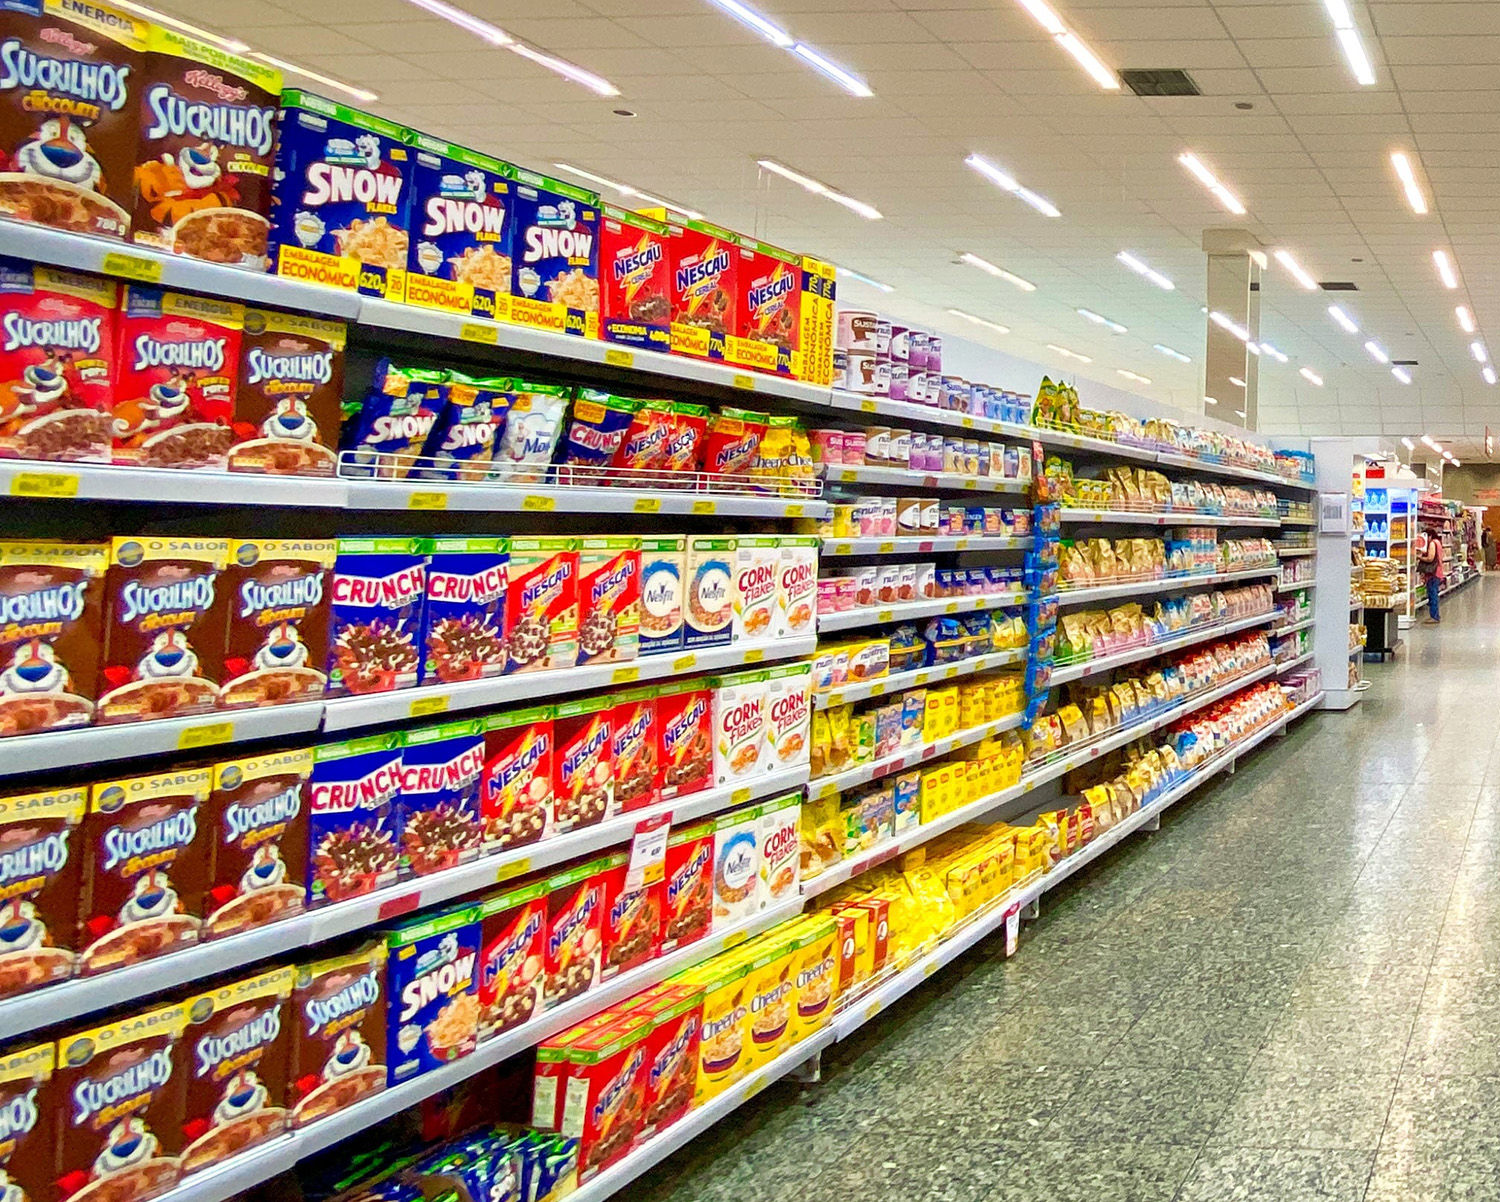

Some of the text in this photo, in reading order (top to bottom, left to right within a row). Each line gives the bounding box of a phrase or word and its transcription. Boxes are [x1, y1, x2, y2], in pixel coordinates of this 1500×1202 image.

[0, 41, 130, 110] SUCRILHOS
[149, 87, 275, 156] SUCRILHOS
[303, 163, 402, 206] SNOW
[425, 197, 506, 236] SNOW
[523, 226, 593, 262] SNOW
[614, 241, 663, 281] NESCAU
[282, 261, 357, 289] ECONÔMICA
[676, 250, 730, 292] NESCAU
[748, 273, 795, 311] NESCAU
[409, 286, 470, 312] ECONÔMICA
[511, 310, 564, 330] ECONÔMICA
[4, 312, 101, 353] SUCRILHOS
[135, 335, 226, 372] SUCRILHOS
[671, 334, 708, 352] CONÔMICA
[249, 350, 333, 384] SUCRILHOS
[169, 541, 229, 552] SABOR
[281, 541, 336, 552] SABOR
[240, 572, 325, 618] SUCRILHOS
[333, 565, 424, 605] CRUNCH
[428, 565, 509, 600] CRUNCH
[521, 562, 572, 608] NESCAU
[592, 559, 636, 603] NESCAU
[738, 563, 773, 592] CORN
[782, 562, 812, 589] CORN
[0, 581, 88, 624] UCRILHOS
[122, 573, 216, 623] SUCRILHOS
[663, 699, 706, 752] NESCAU
[723, 699, 759, 732] CORN
[771, 690, 804, 722] CORN
[400, 747, 484, 791] CRUNCH
[488, 734, 549, 801] NESCAU
[560, 723, 610, 783] NESCAU
[150, 771, 210, 789] SABOR
[312, 761, 401, 811] CRUNCH
[225, 783, 302, 844] SUCRILHOS
[104, 806, 198, 871] SUCRILHOS
[764, 823, 795, 859] CORN
[667, 844, 711, 904] NESCAU
[549, 886, 599, 957] NESCAU
[484, 910, 542, 986] NESCAU
[304, 969, 379, 1036] SUCRILHOS
[400, 953, 476, 1022] SNOW
[196, 1004, 281, 1078] SUCRILHOS
[73, 1044, 173, 1126] SUCRILHOS
